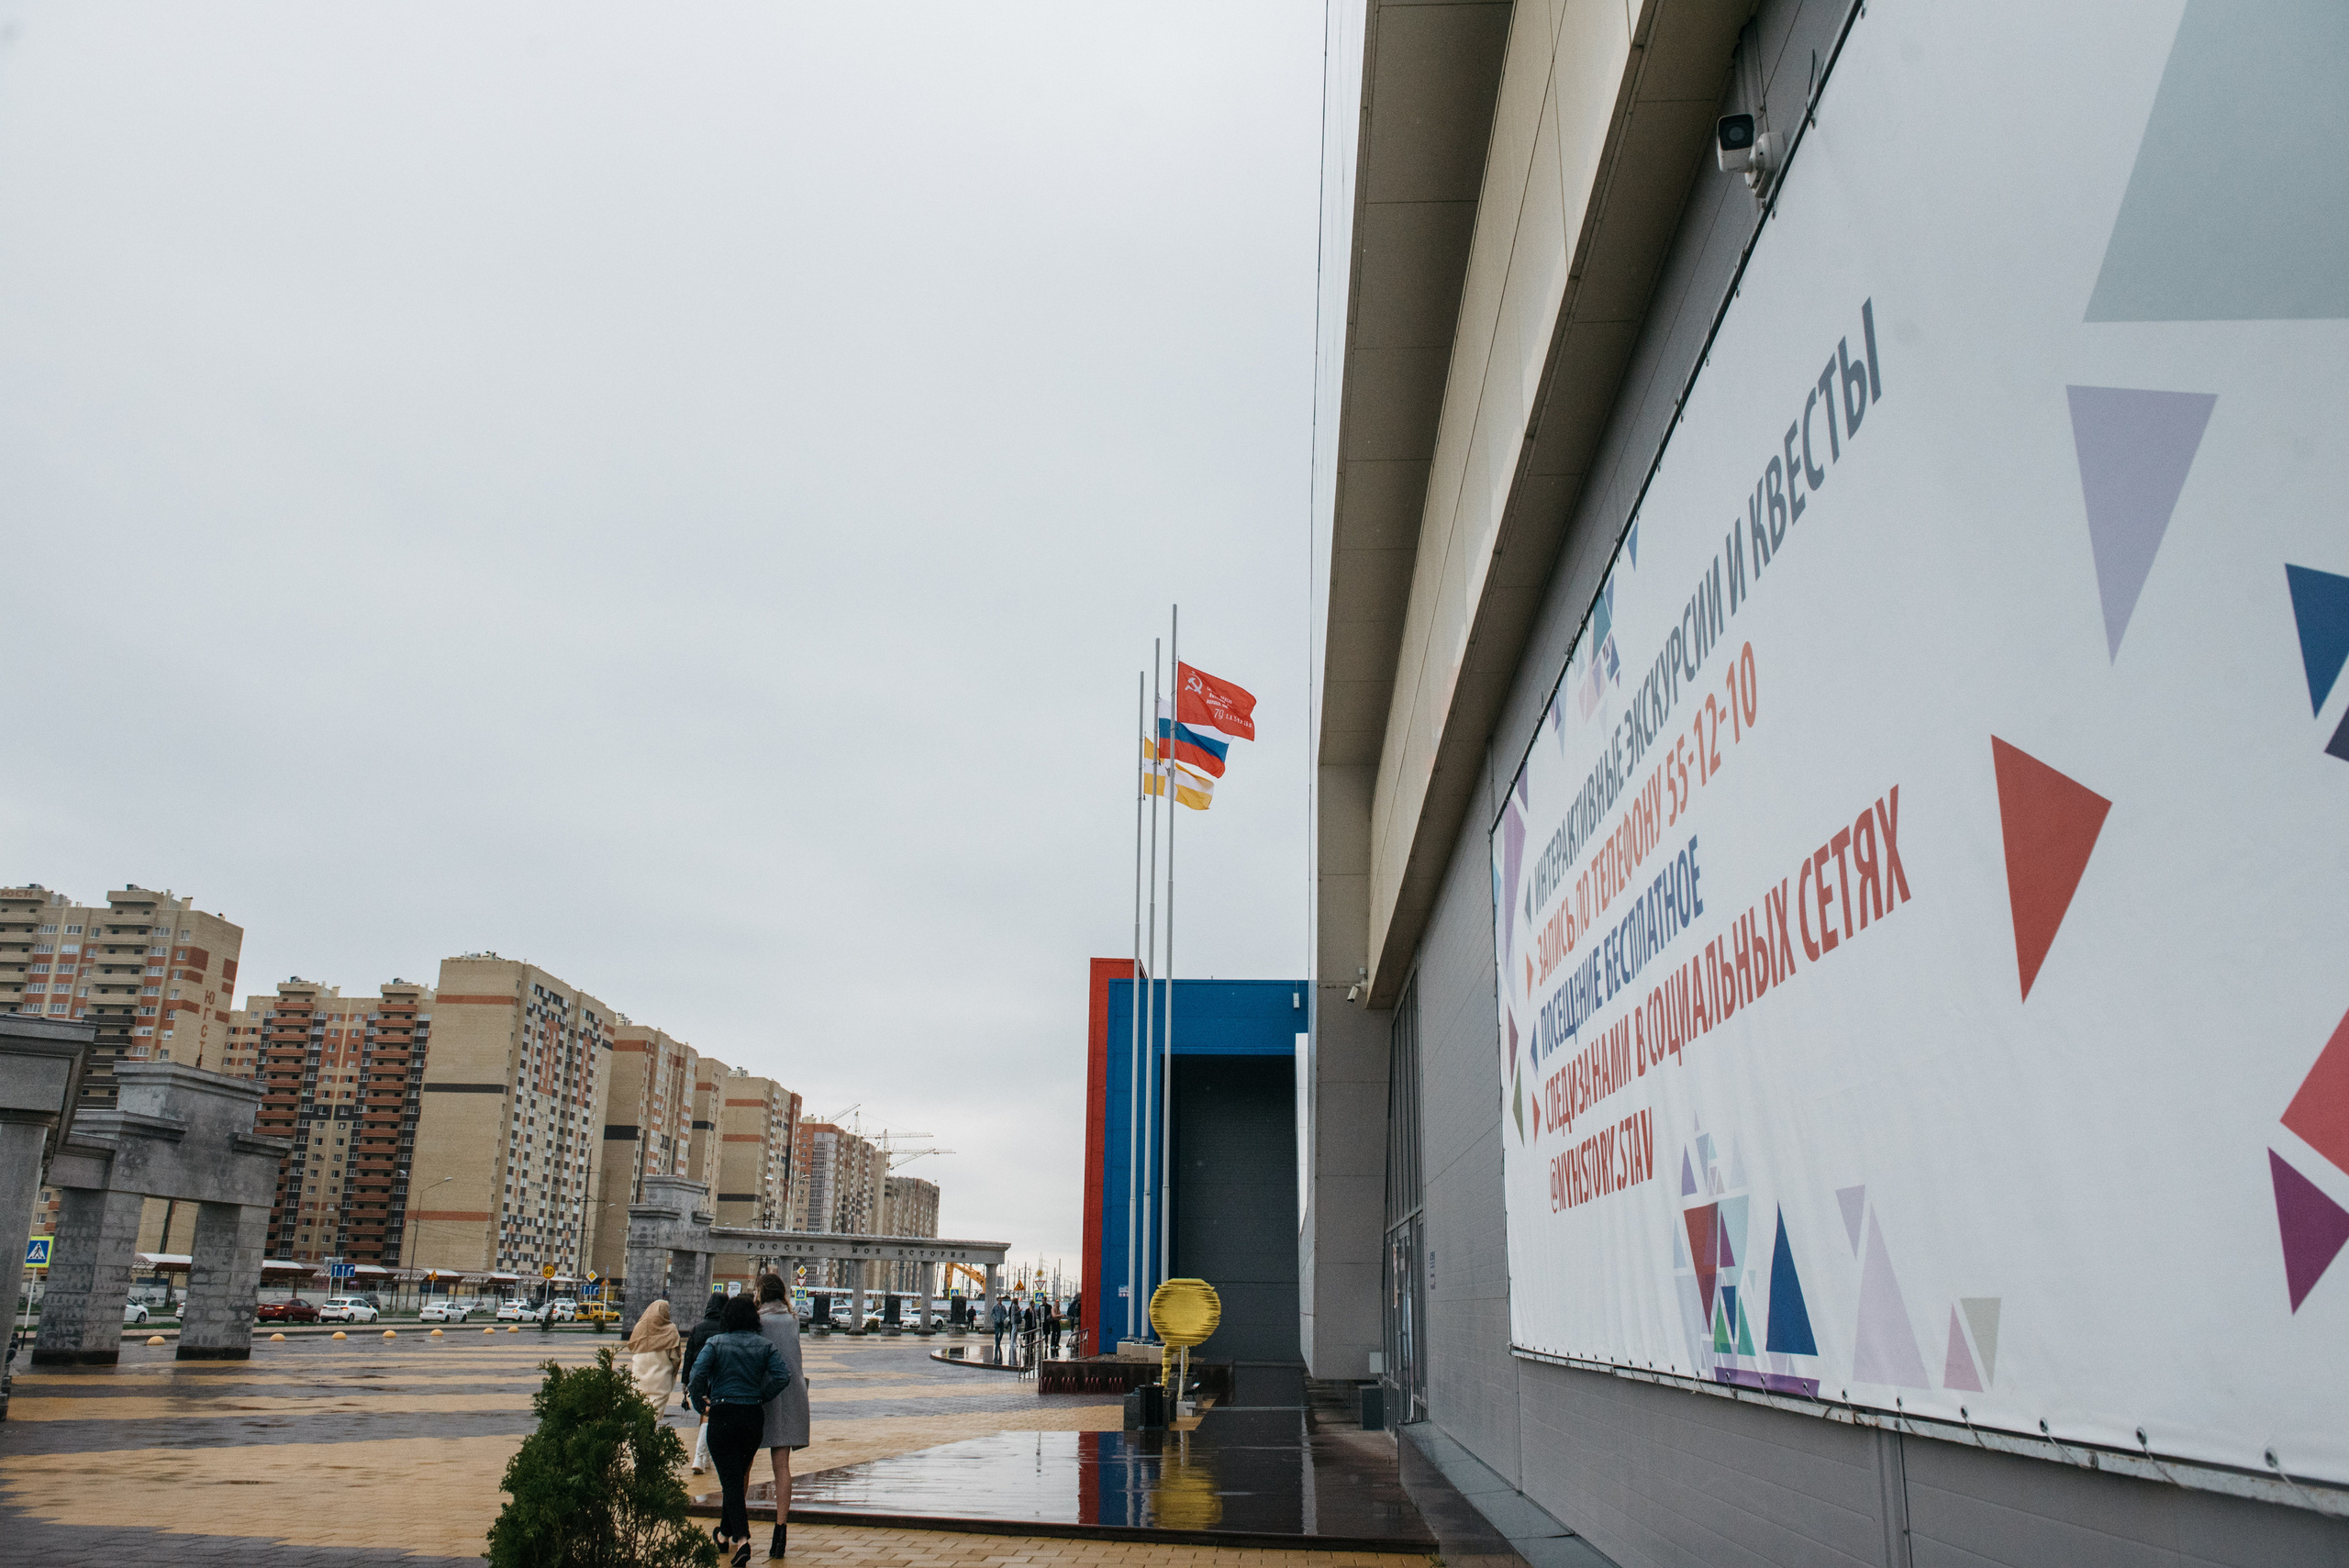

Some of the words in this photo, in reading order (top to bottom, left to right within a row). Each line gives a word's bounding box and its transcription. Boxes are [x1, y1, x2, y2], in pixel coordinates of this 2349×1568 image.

[1534, 723, 1624, 916] ИНТЕРАКТИВНЫЕ
[1624, 553, 1724, 778] ЭКСКУРСИИ
[1725, 516, 1747, 617] И
[1748, 295, 1882, 583] КВЕСТЫ
[1537, 895, 1575, 986] ЗАПИСЬ
[1575, 869, 1590, 940] ПО
[1591, 763, 1661, 919] ТЕЛЕФОНУ
[1666, 640, 1757, 828] 55-12-10
[196, 989, 216, 1066] ЮГСТ
[1540, 945, 1603, 1061] ПОСЕЩЕНИЕ
[1604, 833, 1704, 1002] БЕСПЛАТНОЕ
[1545, 1059, 1578, 1138] СЛЕДИ
[1577, 1048, 1592, 1115] ЗА
[1591, 1014, 1631, 1104] НАМИ
[1634, 1006, 1647, 1077] В
[1647, 876, 1797, 1067] СОЦИАЛЬНЫХ
[1798, 783, 1912, 962] СЕТЯХ
[747, 1242, 815, 1251] РОССИЯ
[852, 1247, 881, 1255] МОЯ
[897, 1249, 966, 1259] ИСТОРИЯ
[1549, 1106, 1653, 1214] @MYHISTORY.STAV
